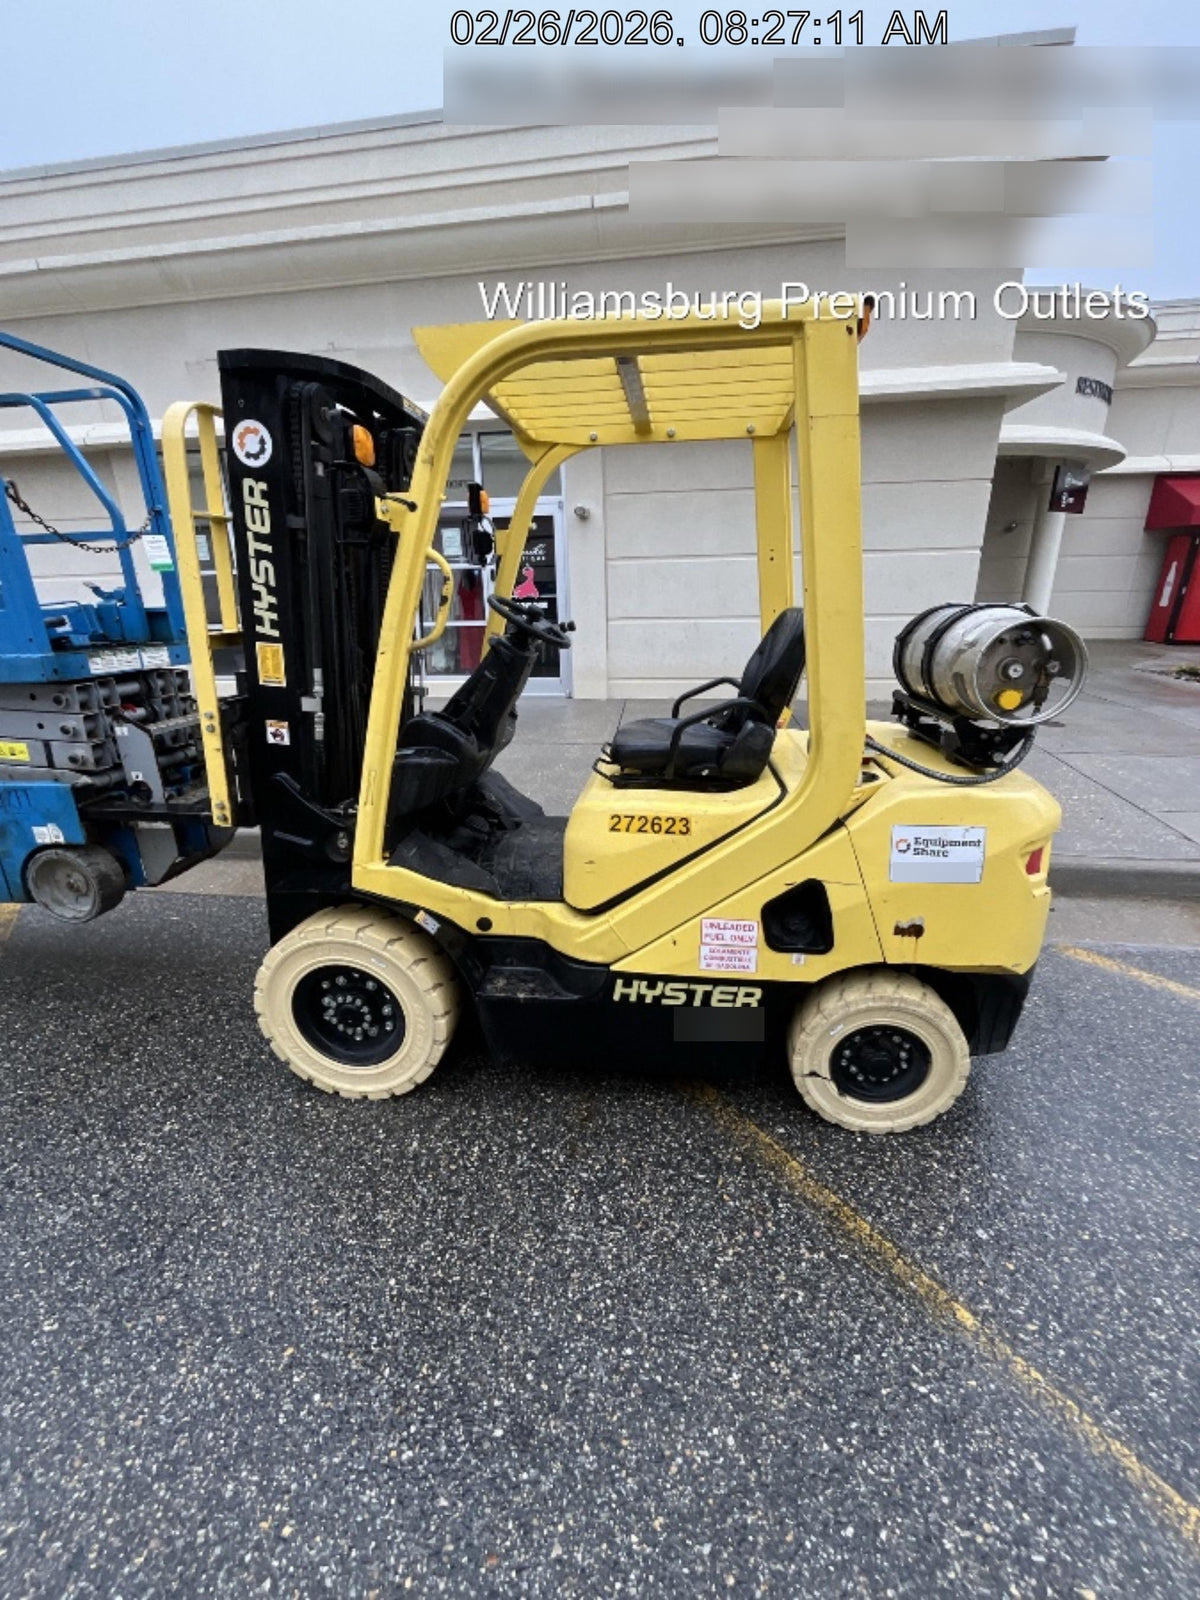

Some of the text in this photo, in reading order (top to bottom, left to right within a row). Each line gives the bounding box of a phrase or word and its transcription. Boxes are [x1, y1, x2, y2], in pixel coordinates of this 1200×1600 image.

[242, 477, 280, 638] HYSTER
[608, 813, 691, 836] 272623
[913, 836, 983, 849] Equipment
[912, 847, 950, 858] Share
[704, 922, 755, 932] UNLEADED
[730, 934, 754, 943] ONLY
[612, 978, 763, 1008] HYSTER
